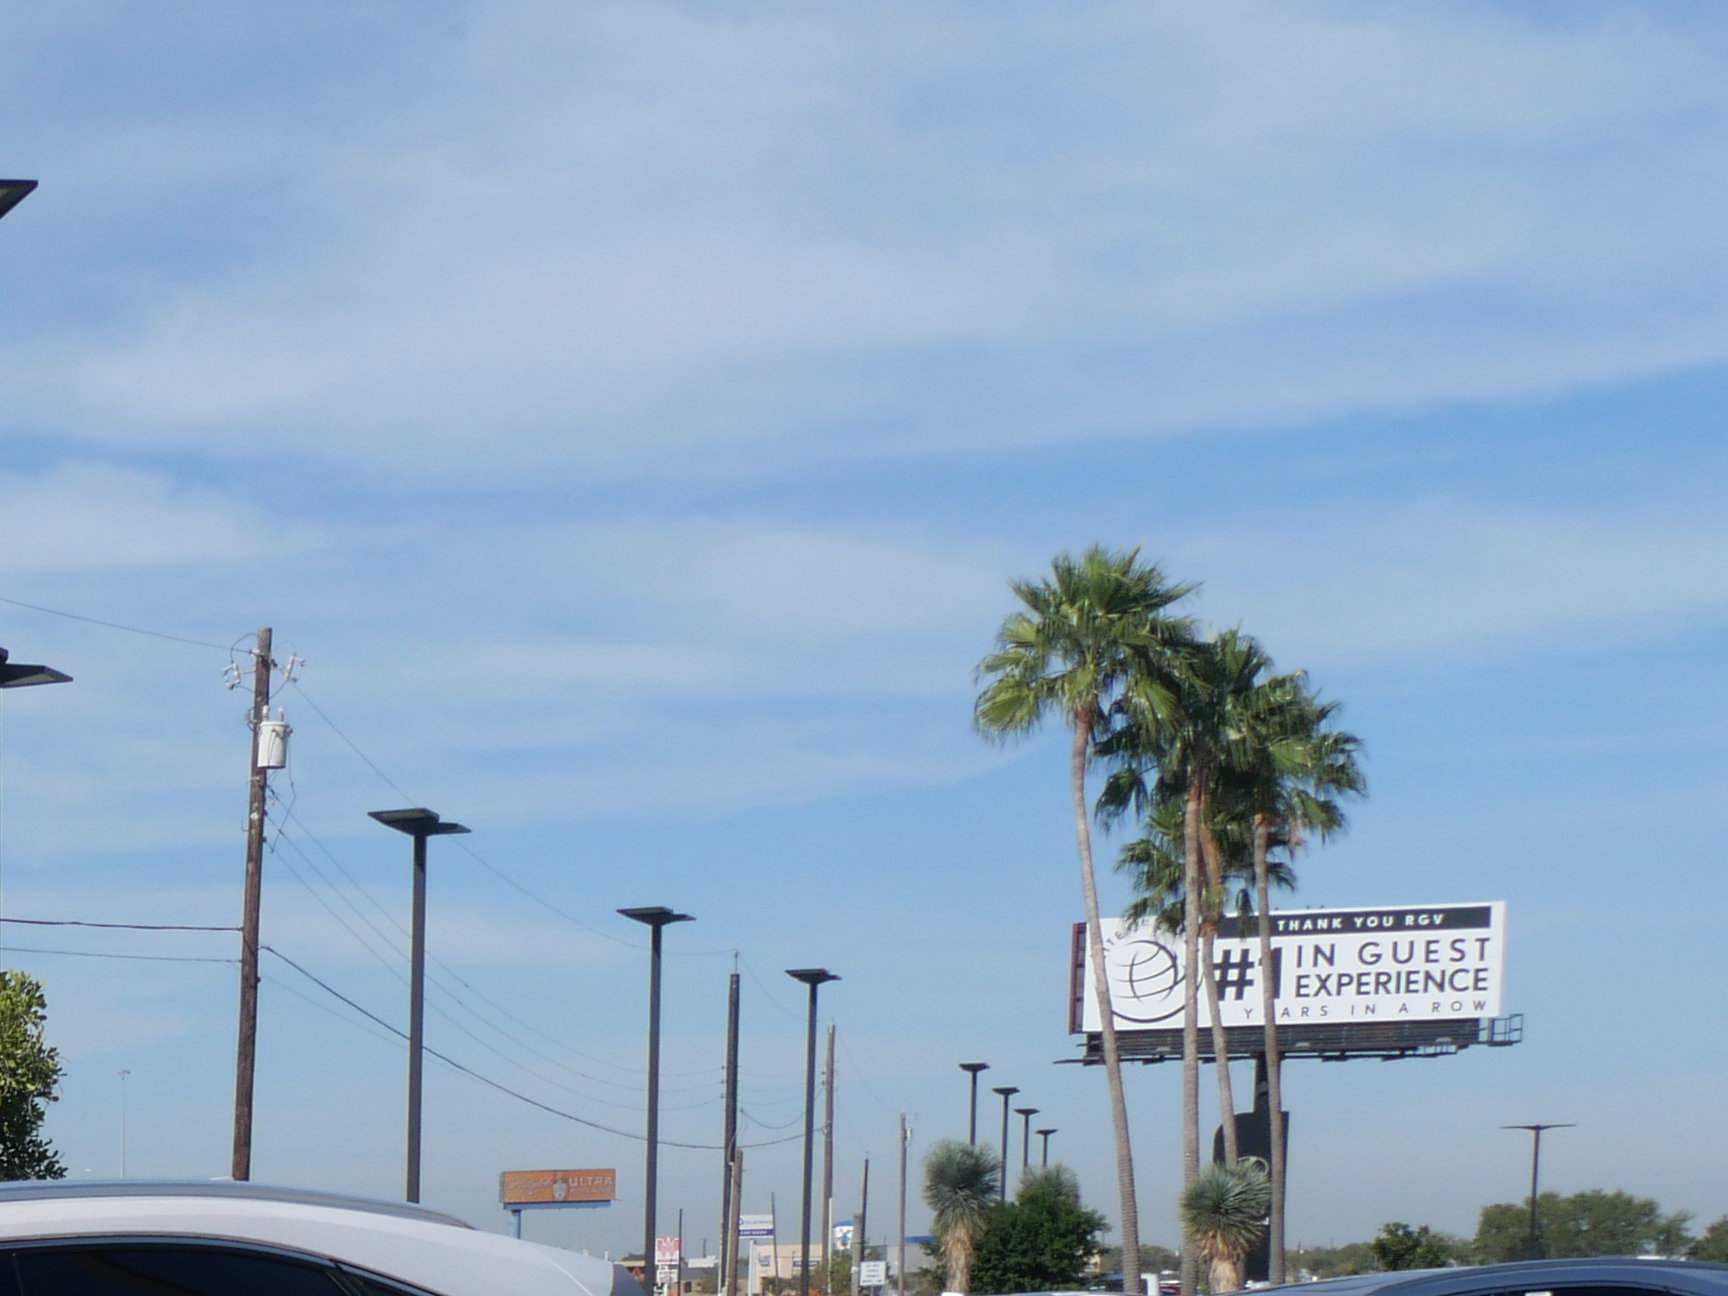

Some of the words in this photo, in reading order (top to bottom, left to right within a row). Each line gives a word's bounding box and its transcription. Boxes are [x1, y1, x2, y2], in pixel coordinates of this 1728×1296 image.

[1277, 917, 1343, 932] THANK
[1354, 915, 1394, 929] YOU
[1405, 913, 1445, 927] RGV
[1296, 943, 1335, 968] IN
[1358, 937, 1490, 966] GUEST
[1213, 947, 1283, 1001] #1
[1295, 968, 1488, 998] EXPERIENCE
[1244, 1005, 1329, 1019] YARS
[1351, 1004, 1376, 1016] IN
[1399, 1003, 1409, 1014] A
[1432, 1000, 1487, 1014] ROW
[568, 1176, 613, 1187] ULTRA
